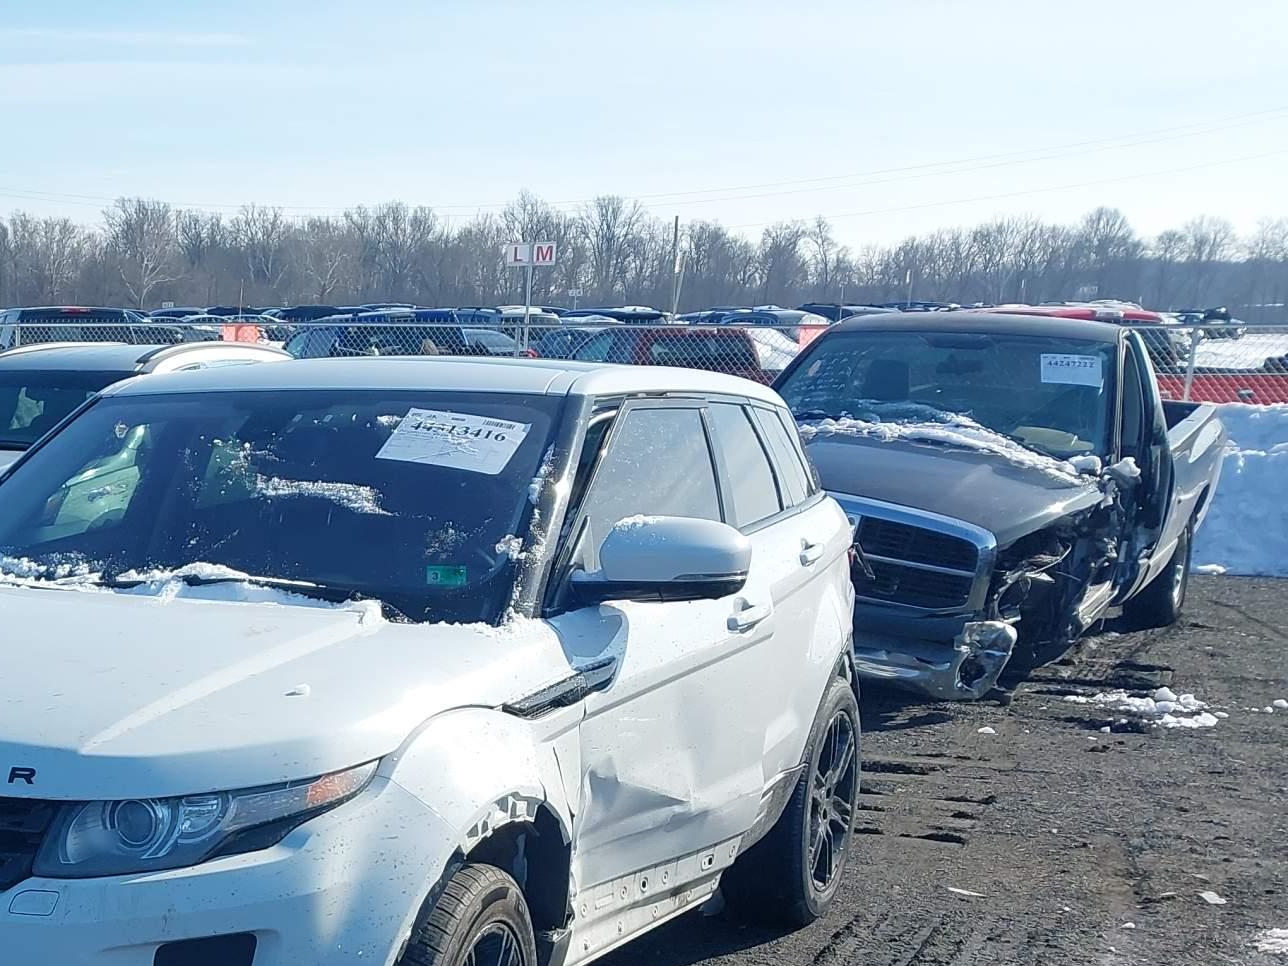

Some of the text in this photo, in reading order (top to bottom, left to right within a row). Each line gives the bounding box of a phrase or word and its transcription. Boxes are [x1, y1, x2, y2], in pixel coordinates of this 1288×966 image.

[513, 245, 553, 262] L M
[410, 420, 506, 442] 4413416
